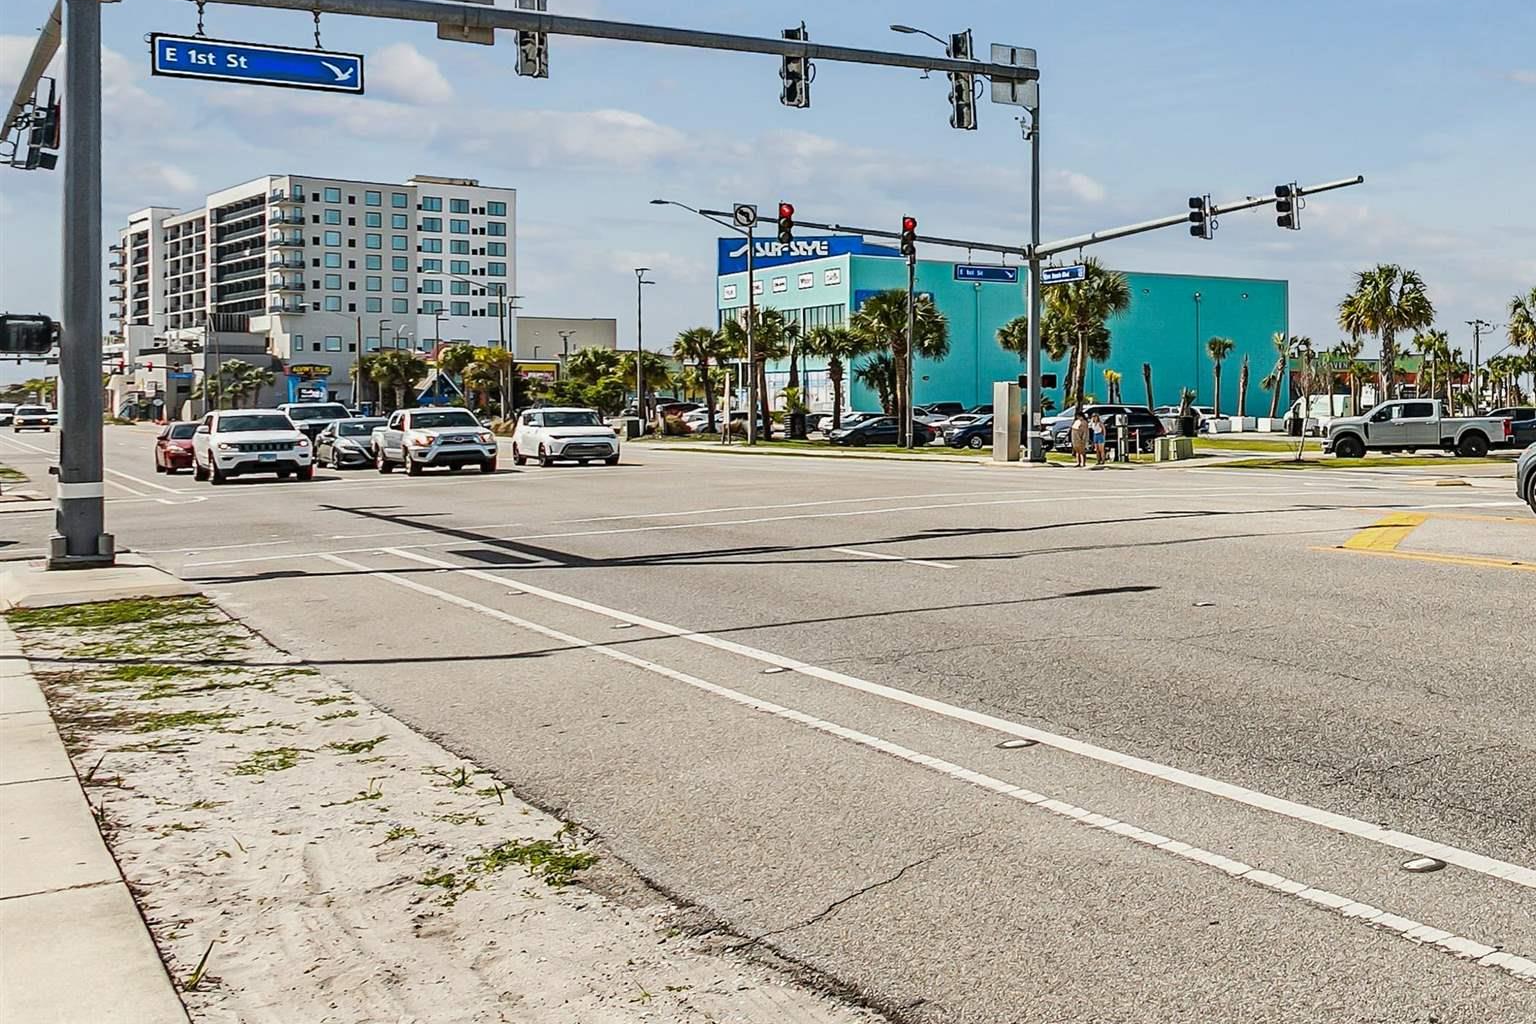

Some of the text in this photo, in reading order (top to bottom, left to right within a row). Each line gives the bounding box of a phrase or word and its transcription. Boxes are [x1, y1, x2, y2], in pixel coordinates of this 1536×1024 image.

[165, 47, 248, 69] E 1st St
